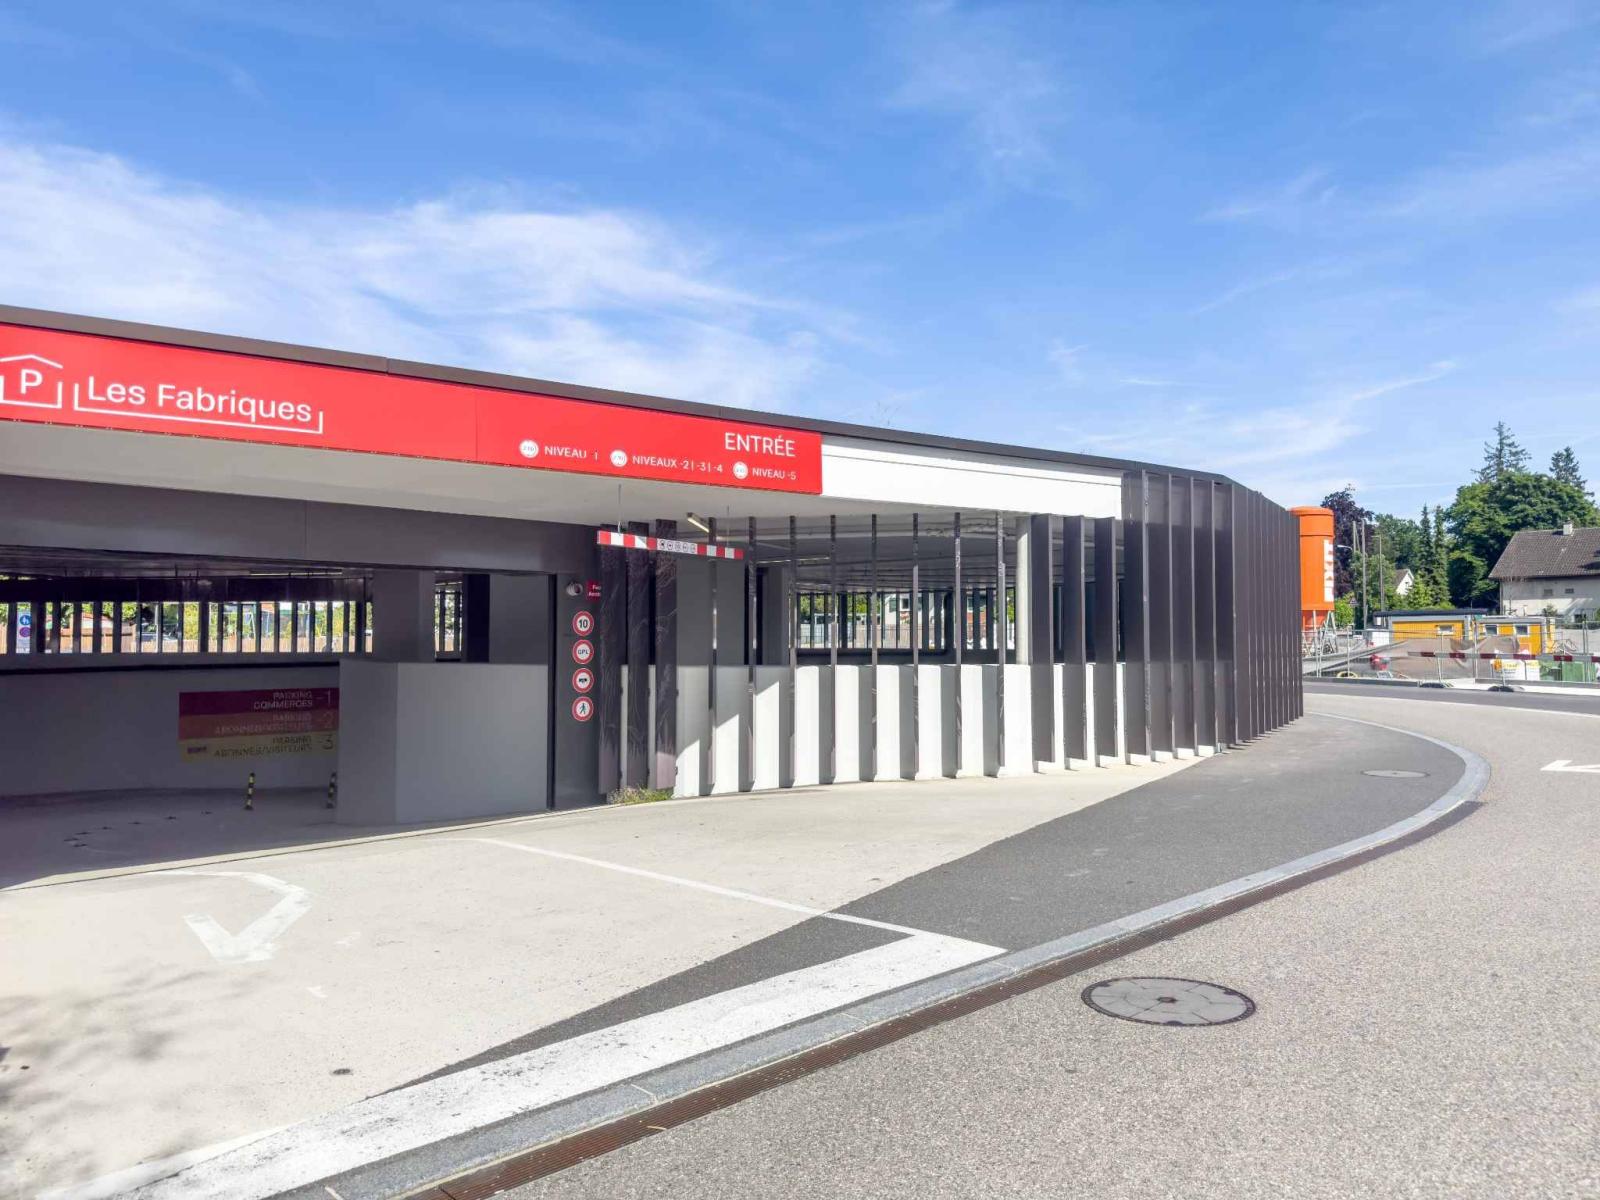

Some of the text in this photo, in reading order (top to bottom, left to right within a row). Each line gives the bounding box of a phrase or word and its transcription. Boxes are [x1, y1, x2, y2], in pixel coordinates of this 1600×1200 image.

[20, 368, 43, 394] P
[88, 375, 312, 423] Les Fabriques
[724, 432, 796, 457] ENTRÉE
[544, 446, 587, 459] NIVEAU
[632, 455, 677, 468] NIVEAUX
[752, 467, 786, 480] NIVEAU
[579, 619, 588, 628] 10
